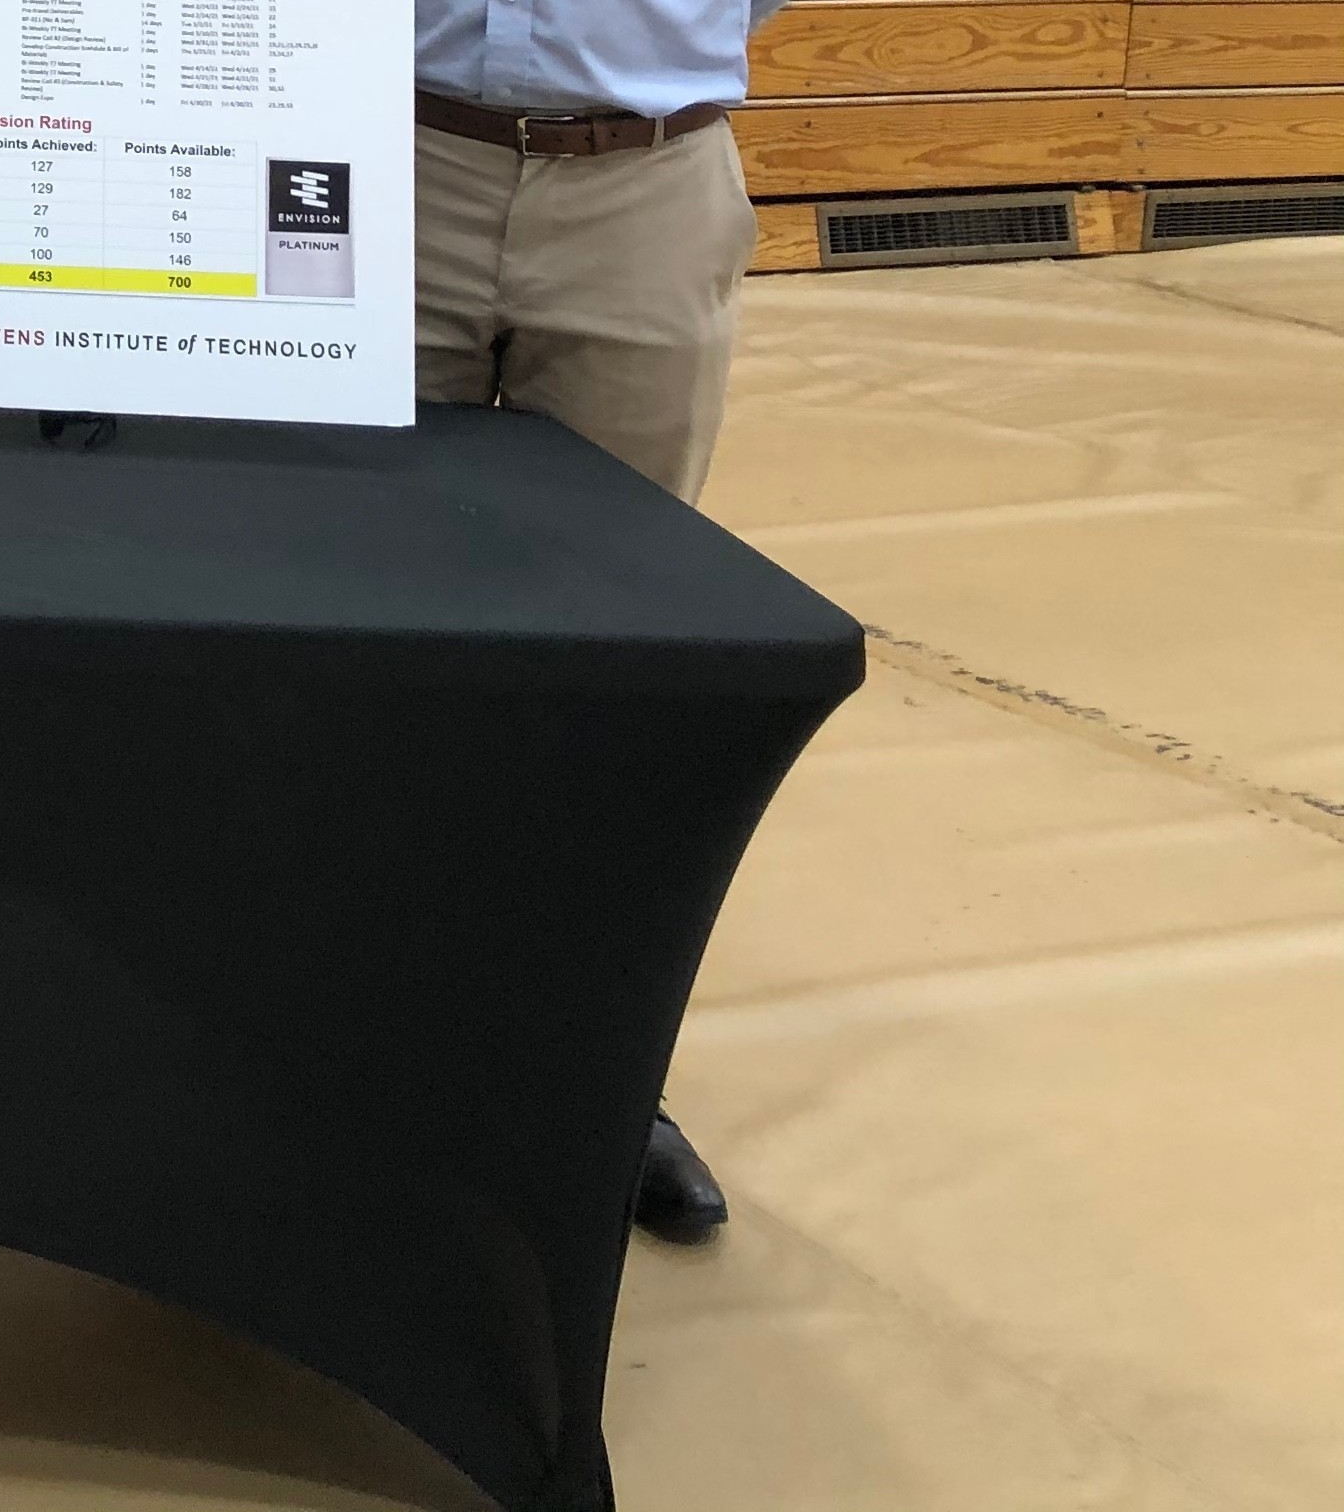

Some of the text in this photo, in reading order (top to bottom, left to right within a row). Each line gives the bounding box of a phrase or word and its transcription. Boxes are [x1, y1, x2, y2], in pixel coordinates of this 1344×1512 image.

[40, 116, 92, 134] Rating
[32, 139, 97, 152] Achieved:
[125, 142, 235, 157] Points Available:
[31, 161, 53, 172] 127
[170, 166, 192, 178] 158
[31, 182, 53, 194] 129
[170, 188, 191, 200] 182
[33, 204, 49, 216] 27
[172, 210, 187, 221] 64
[278, 213, 340, 224] ENVISION
[34, 226, 49, 238] 70
[169, 232, 192, 244] 150
[278, 240, 339, 251] PLATINUM
[30, 248, 52, 260] 100
[169, 254, 192, 266] 146
[28, 270, 56, 282] 453
[167, 275, 192, 288] 700
[56, 331, 168, 352] INSTITUTE
[178, 334, 197, 355] of
[204, 338, 356, 359] TECHNOLOGY
